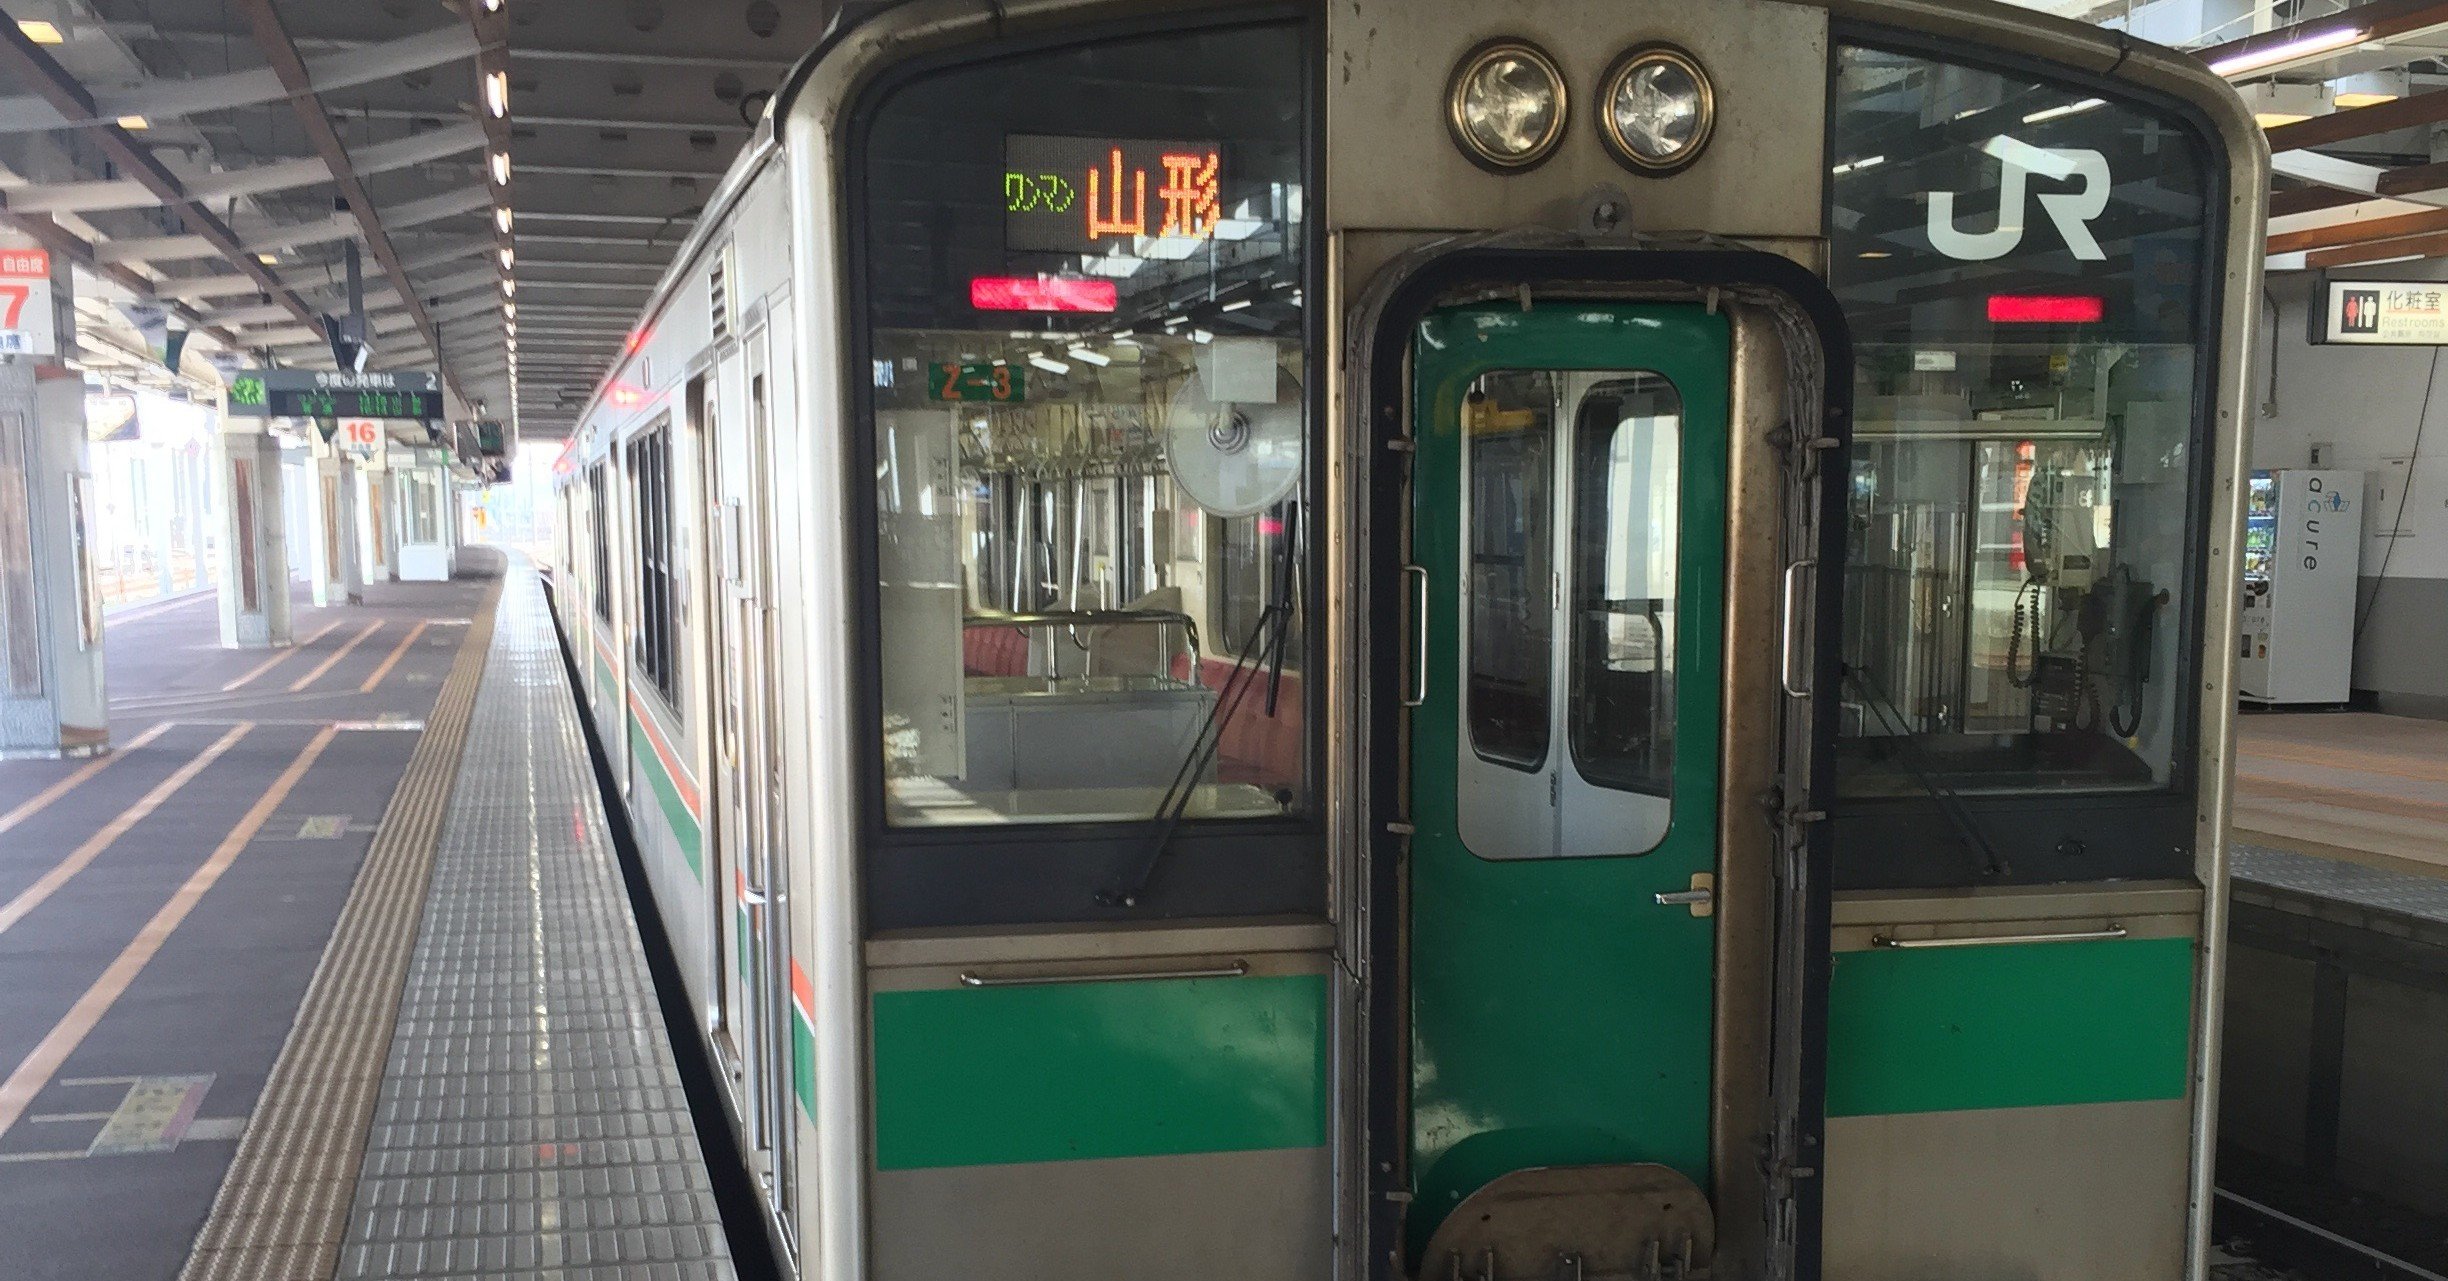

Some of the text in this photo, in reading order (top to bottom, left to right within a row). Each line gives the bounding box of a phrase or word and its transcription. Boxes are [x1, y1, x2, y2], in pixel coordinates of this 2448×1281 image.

[1087, 147, 1220, 240] 山形
[1927, 147, 2111, 261] JR
[3, 256, 44, 273] 自由席
[2387, 290, 2441, 311] 化粧室
[2382, 316, 2446, 328] Restrooms
[425, 371, 438, 391] 2
[346, 422, 376, 443] 16
[2304, 477, 2323, 571] acure
